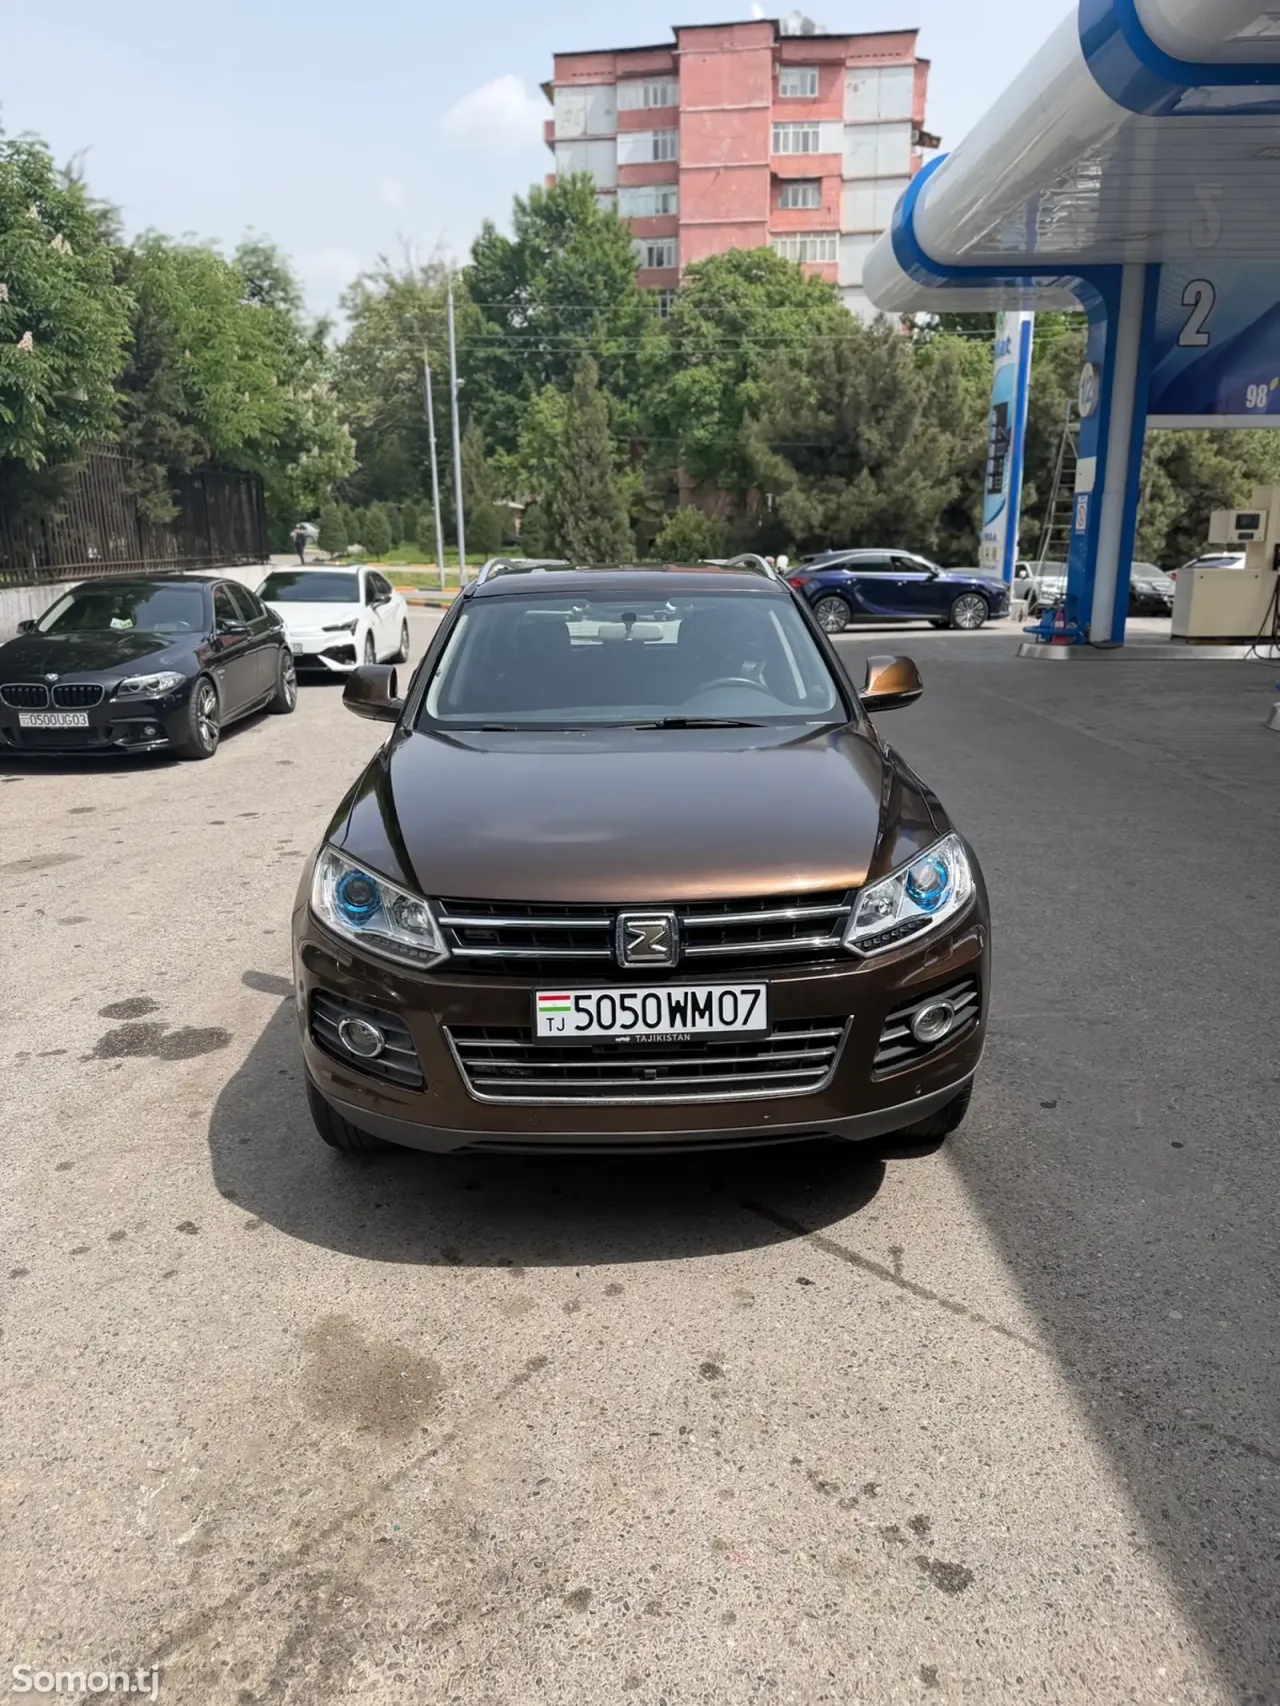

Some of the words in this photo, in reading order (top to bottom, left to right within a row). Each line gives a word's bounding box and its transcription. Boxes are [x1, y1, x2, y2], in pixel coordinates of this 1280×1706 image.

[1177, 279, 1216, 347] 2
[1245, 384, 1268, 408] 98
[29, 714, 87, 725] 0500UG03
[574, 989, 761, 1031] 5050WM07
[546, 1017, 565, 1032] TJ
[635, 1034, 691, 1042] TAJIKISTAN
